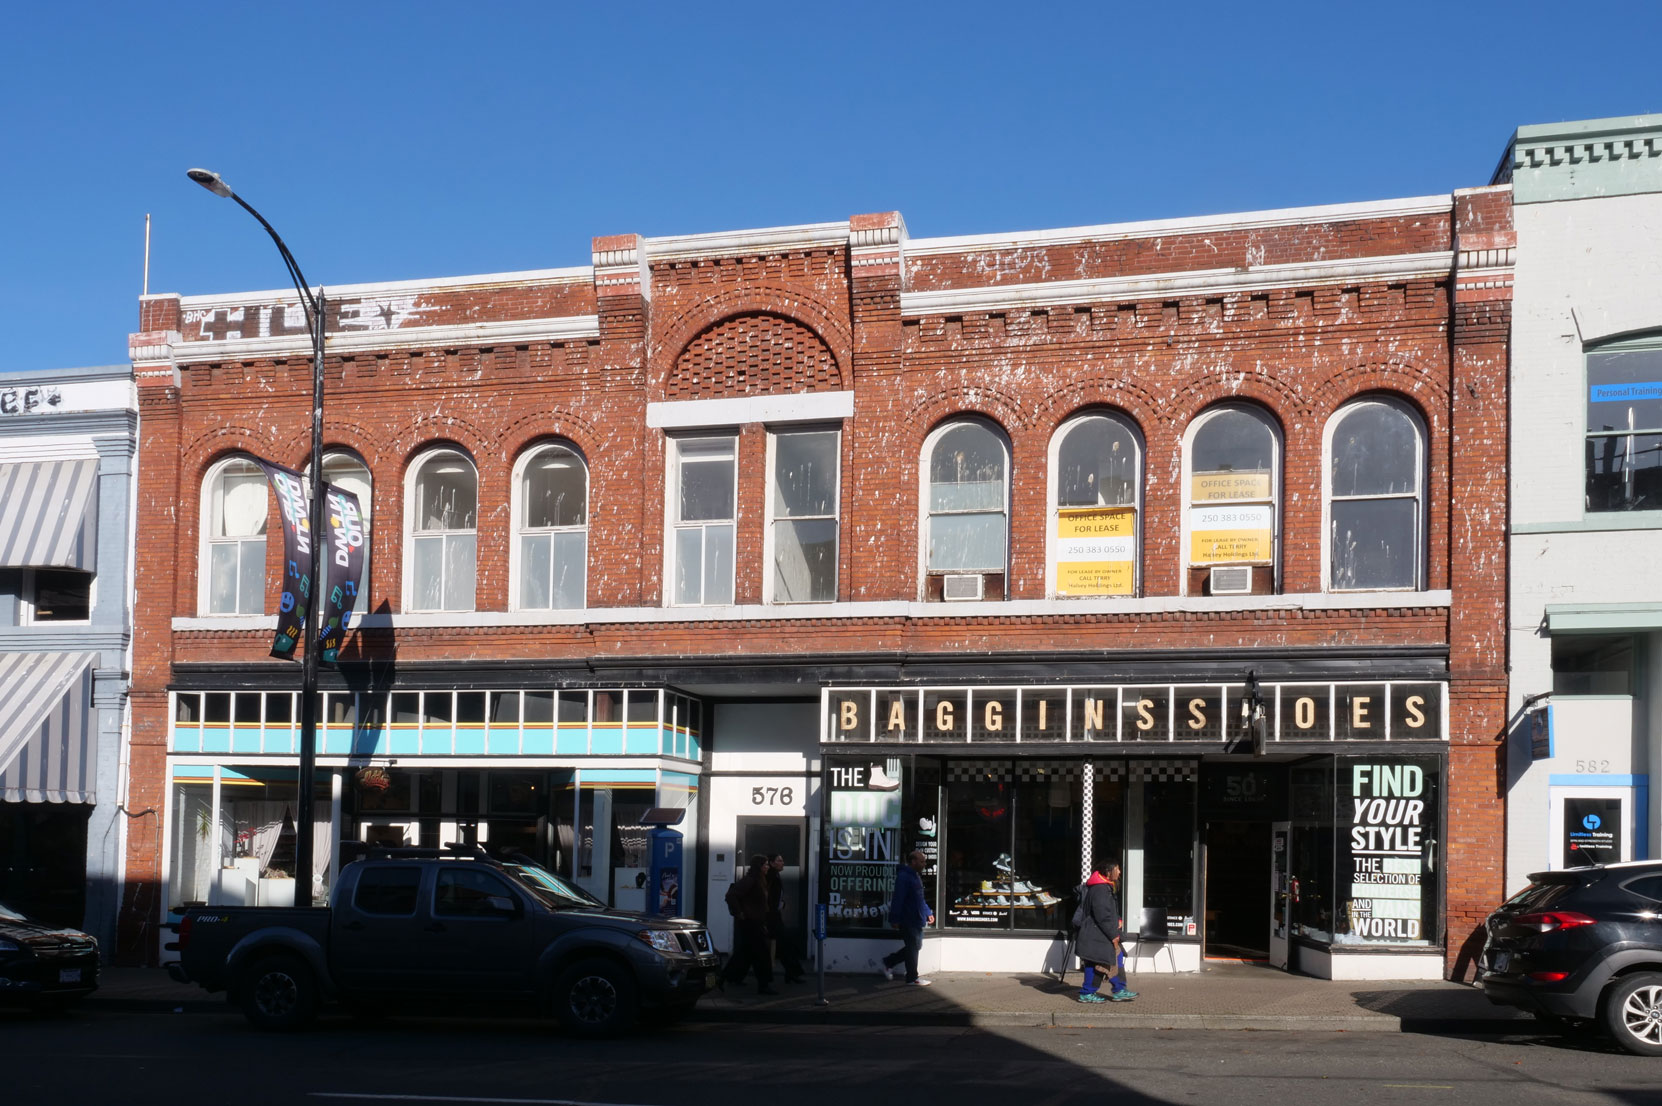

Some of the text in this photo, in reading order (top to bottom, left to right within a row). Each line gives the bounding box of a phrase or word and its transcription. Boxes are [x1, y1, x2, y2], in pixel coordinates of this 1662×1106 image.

[1597, 386, 1662, 397] Personal Training
[1201, 480, 1232, 488] OFFICE
[1068, 513, 1126, 522] OFFICE SPACE
[1202, 513, 1262, 523] 250 383 0550
[840, 699, 1155, 730] BAGGINS
[1576, 760, 1610, 773] 582
[830, 767, 864, 787] THE
[1353, 765, 1423, 797] FIND
[835, 793, 899, 827] DOC
[1353, 798, 1424, 825] YOUR
[829, 829, 853, 859] IS
[1351, 826, 1422, 851] STYLE
[664, 842, 674, 858] P
[830, 866, 854, 877] NOW
[1353, 857, 1420, 873] THE BEST
[830, 877, 895, 892] OFFERING
[1353, 873, 1421, 884] SELECTION OF
[828, 900, 892, 919] Marten
[1352, 899, 1420, 918] AND VANS
[1352, 918, 1419, 938] WORLD
